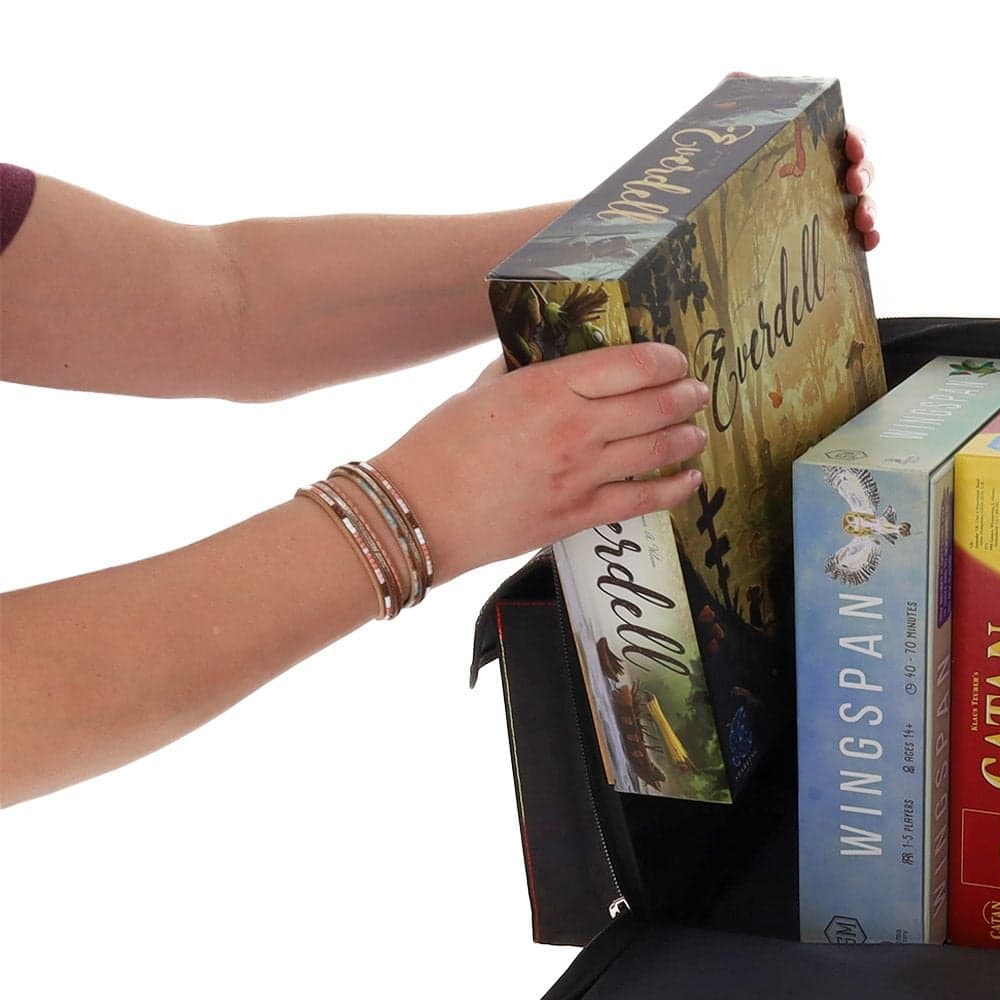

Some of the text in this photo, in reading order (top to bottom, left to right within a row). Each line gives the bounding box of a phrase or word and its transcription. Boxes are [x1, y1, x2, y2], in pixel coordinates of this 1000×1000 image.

[597, 123, 757, 225] Everdell
[695, 213, 826, 433] Everdell
[880, 379, 988, 440] WINGSPAN
[592, 521, 690, 677] erdell
[905, 601, 918, 639] MINUTES
[904, 665, 917, 679] 40
[905, 640, 917, 651] 70
[838, 593, 884, 857] WINGSPAN
[904, 722, 915, 763] AGES 14+
[970, 708, 979, 732] KLAUS
[933, 653, 951, 917] WINGSPAN
[903, 799, 914, 848] 1-5 PLAYERS
